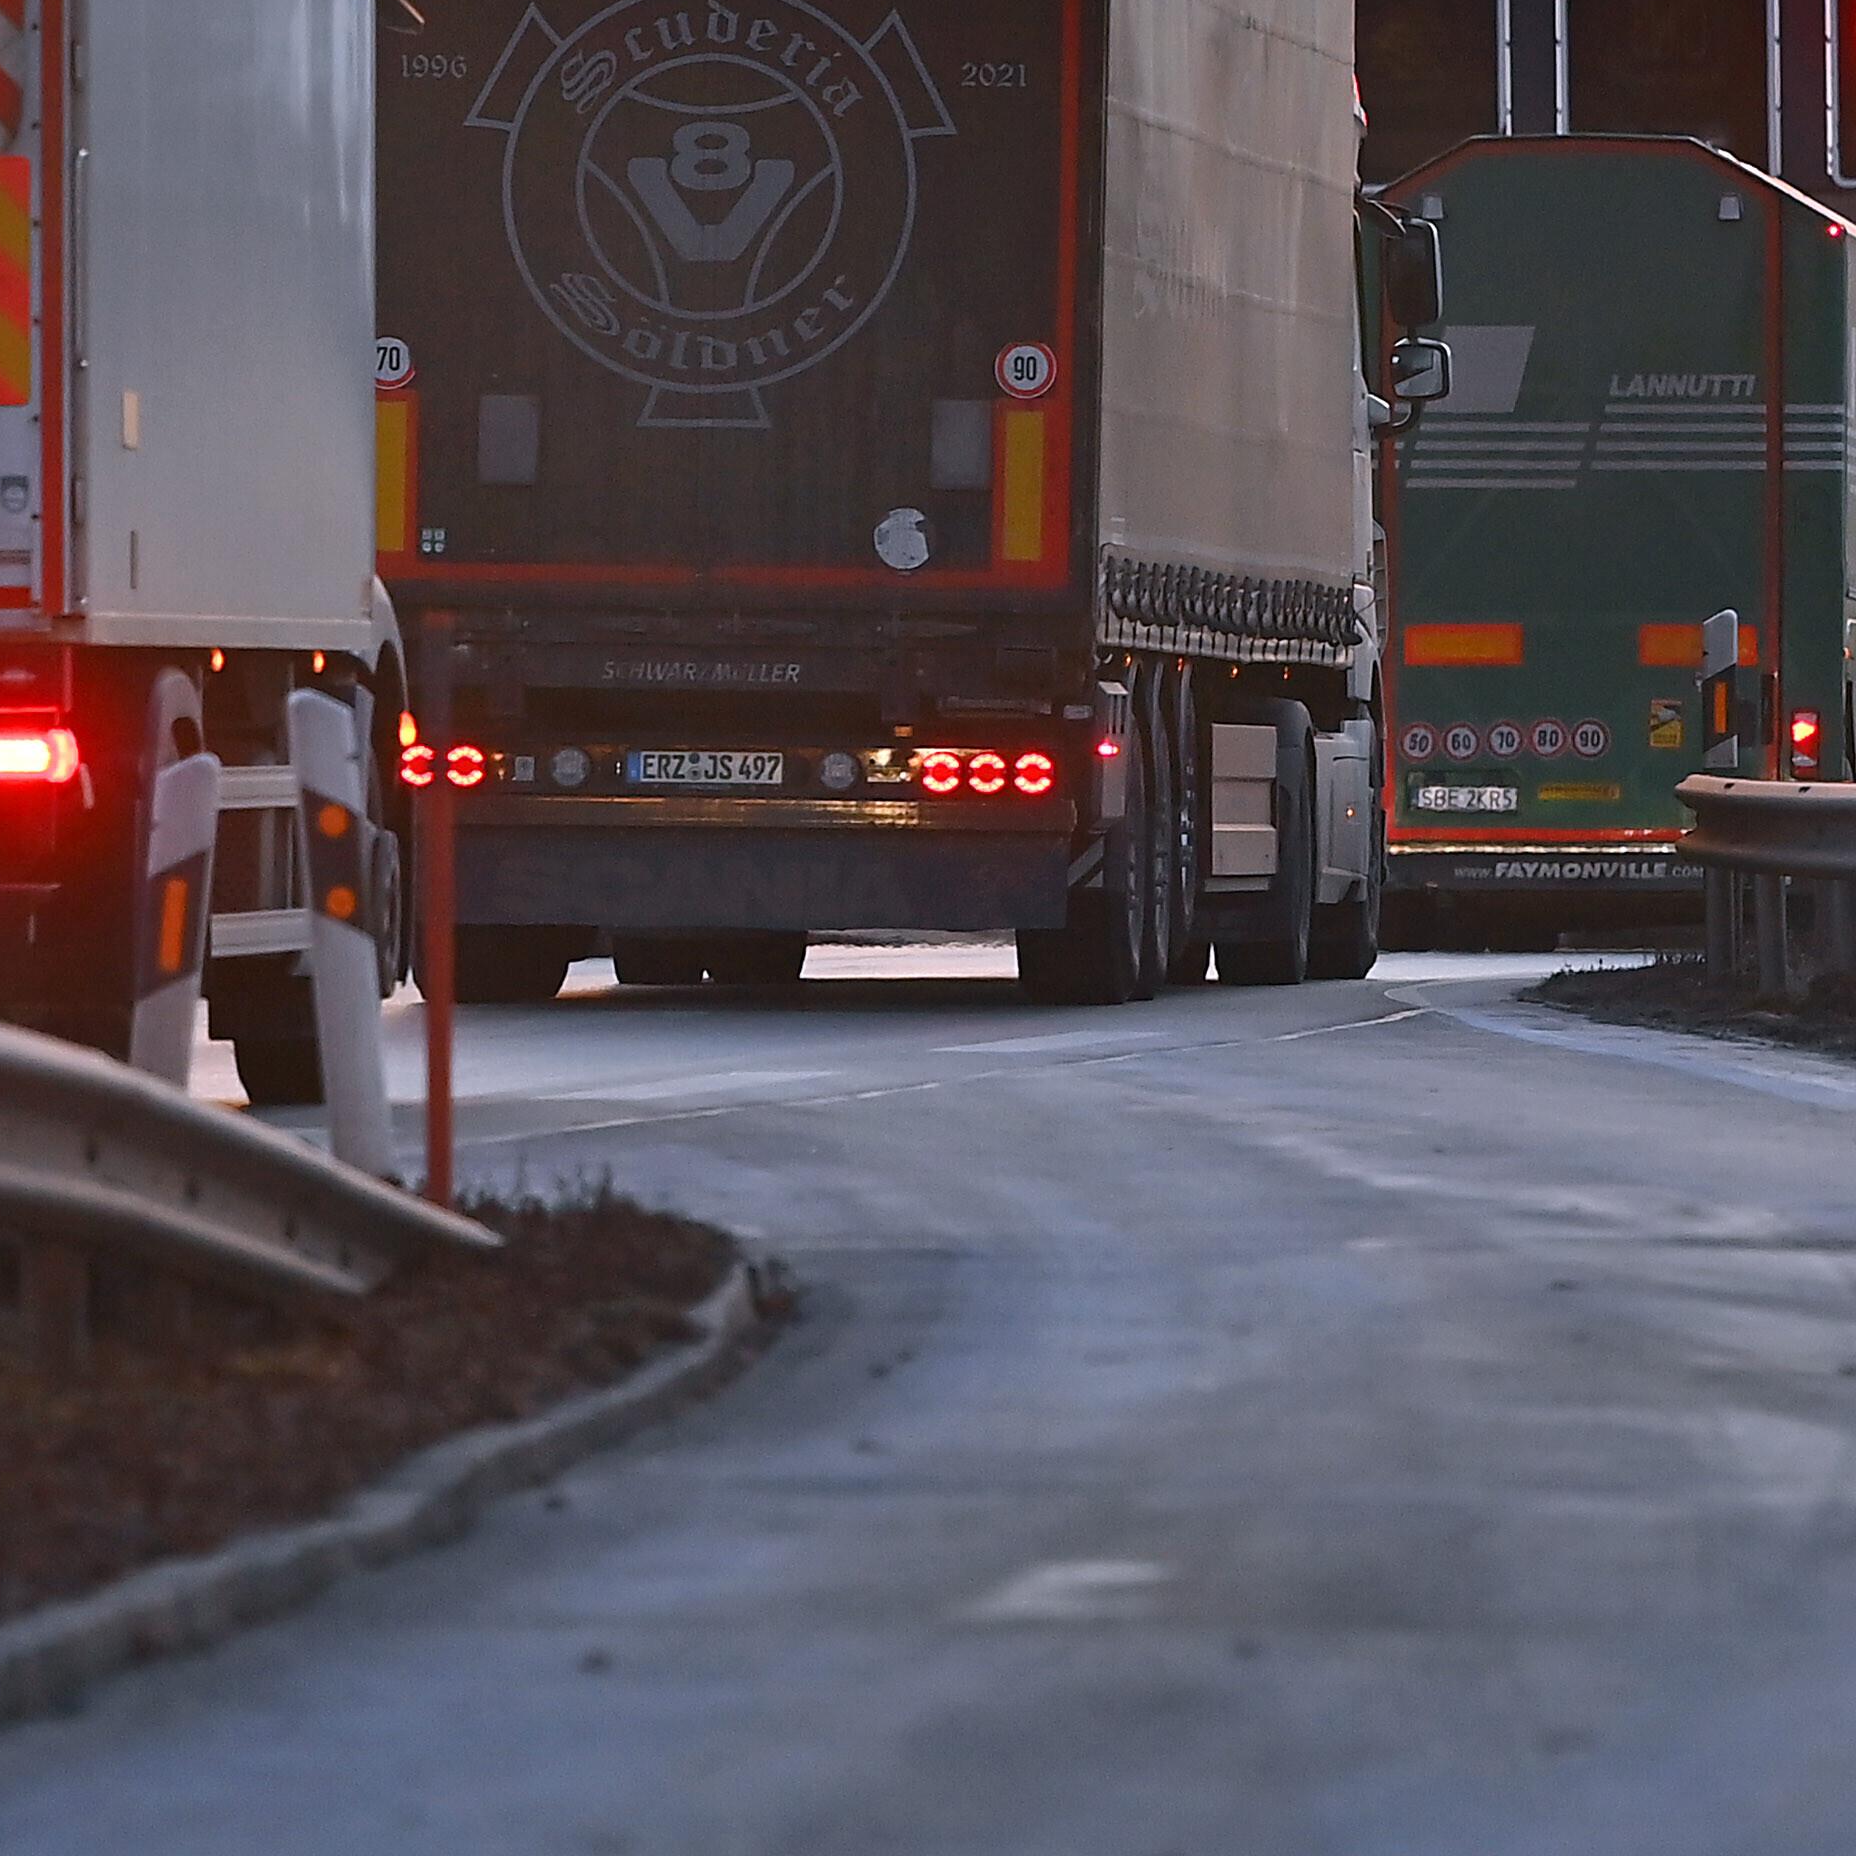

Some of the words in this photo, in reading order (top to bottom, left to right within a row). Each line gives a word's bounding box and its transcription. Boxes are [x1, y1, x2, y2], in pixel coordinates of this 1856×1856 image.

[401, 53, 468, 79] 1996
[960, 62, 1027, 88] 2021
[375, 345, 401, 372] 70
[1013, 355, 1037, 382] 90
[1608, 373, 1757, 397] LANNUTTI
[601, 660, 802, 684] SHWARMLLER
[1408, 732, 1430, 753] 50
[1451, 732, 1472, 751] 60
[1495, 730, 1516, 750] 70
[1537, 728, 1560, 748] 80
[1579, 729, 1601, 748] 90
[642, 754, 686, 780] ERZ
[703, 754, 733, 781] JS
[738, 755, 781, 781] 497
[1421, 789, 1459, 808] SBE
[1466, 789, 1514, 807] 2KR5
